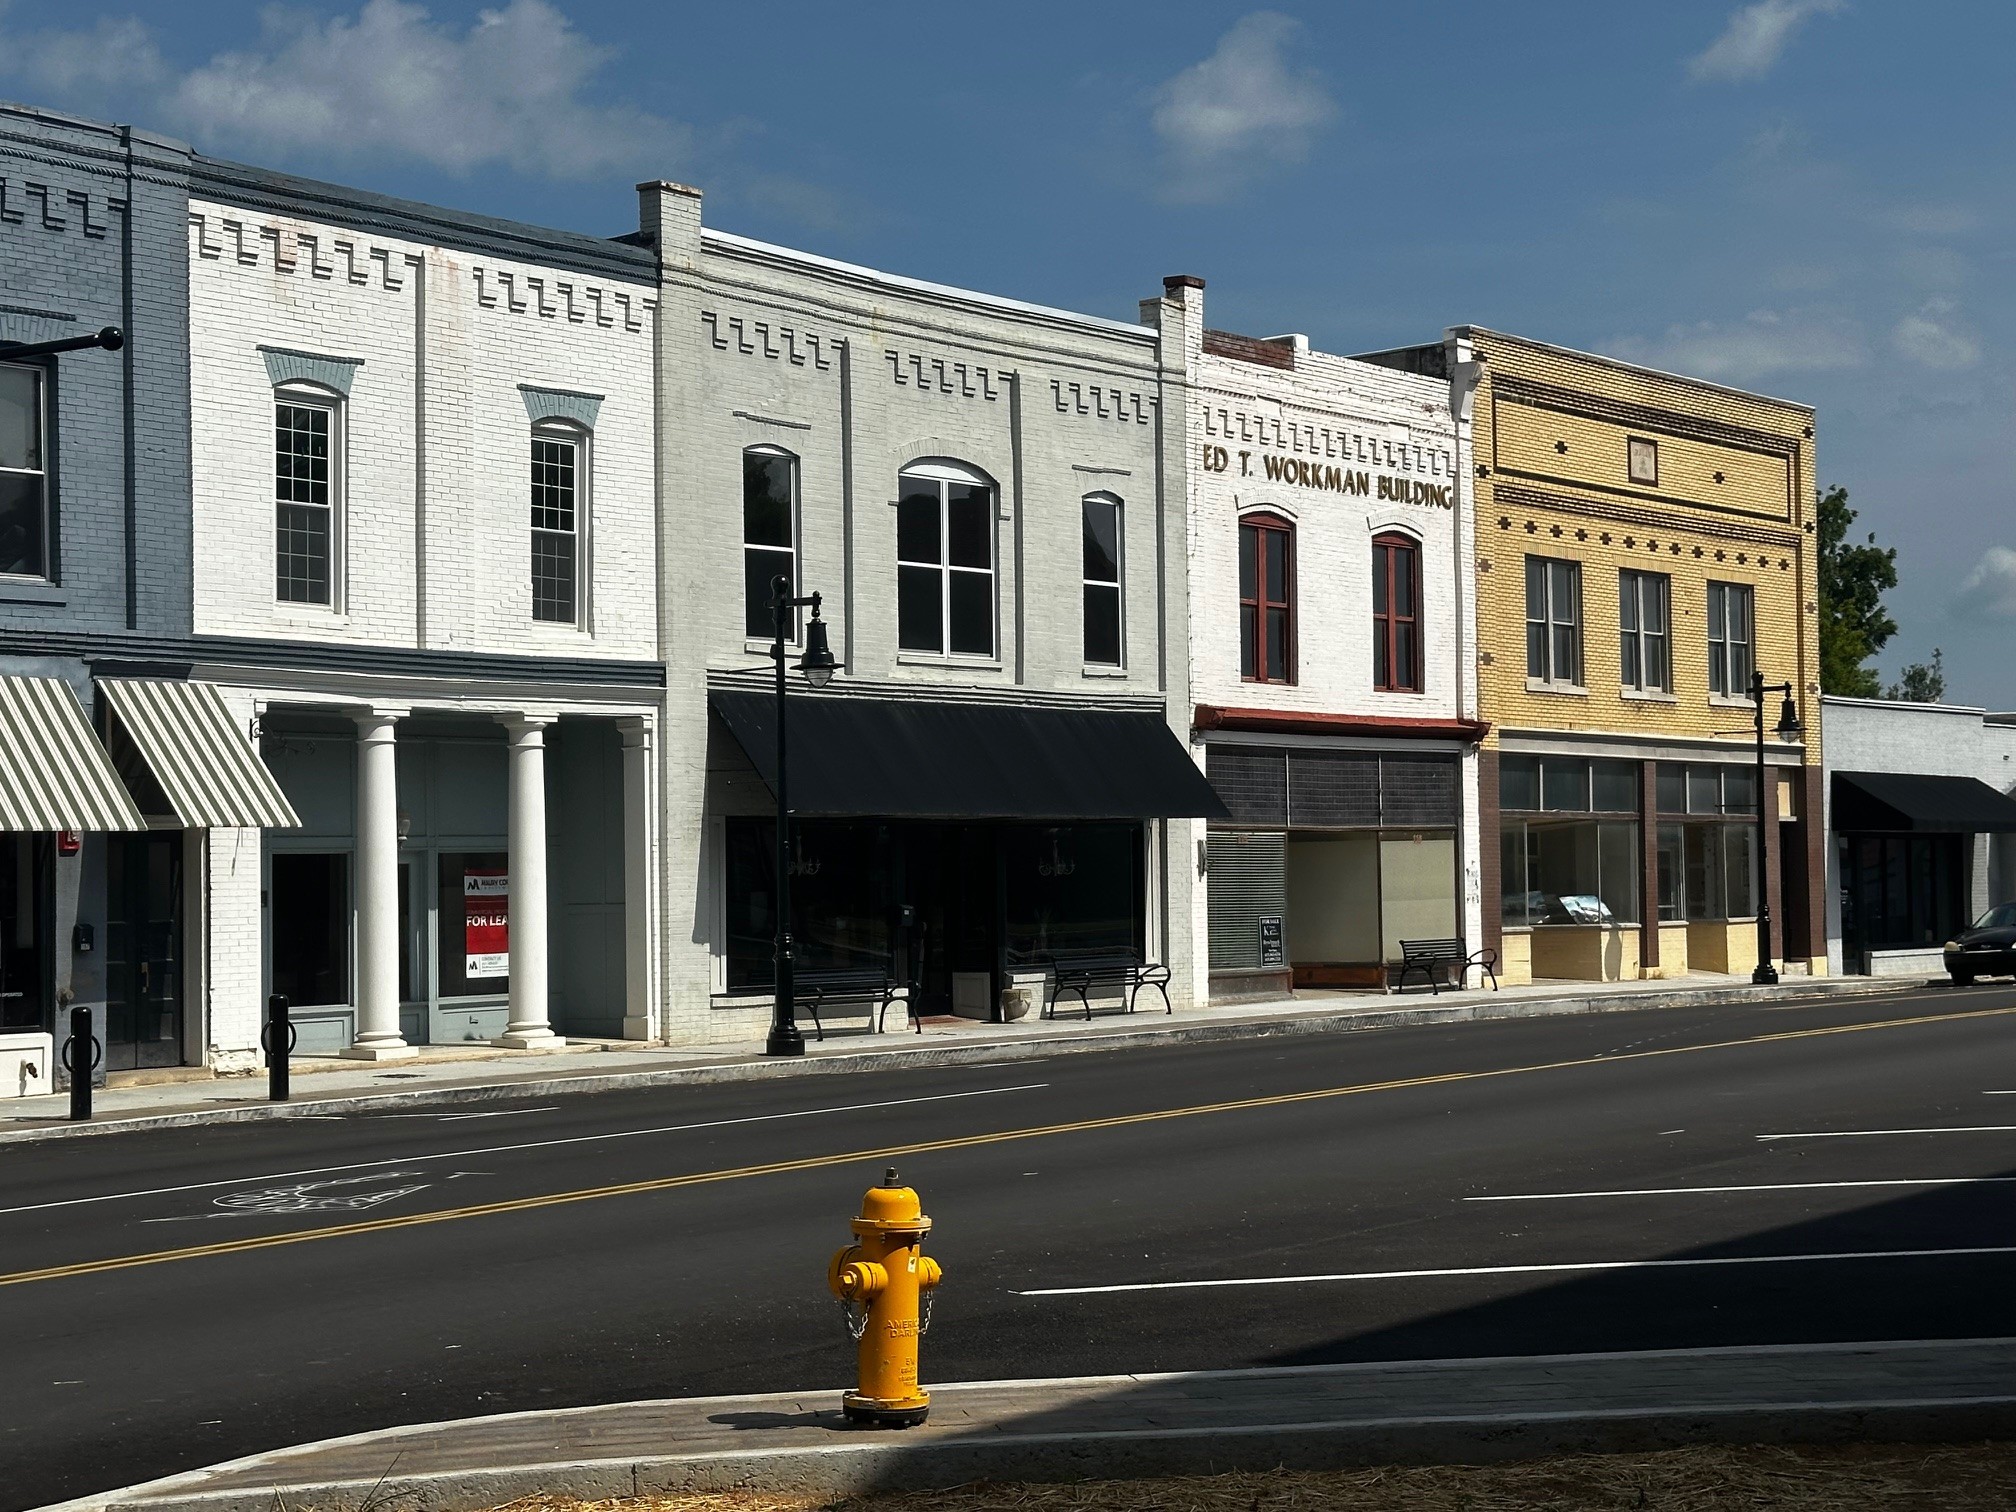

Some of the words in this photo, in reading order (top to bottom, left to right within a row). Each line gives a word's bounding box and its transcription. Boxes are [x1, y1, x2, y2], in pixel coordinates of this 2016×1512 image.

[1203, 444, 1229, 472] ED
[1238, 451, 1253, 477] T.
[1263, 454, 1370, 497] WORKMAN
[1377, 475, 1453, 510] BUILDING
[466, 915, 488, 927] FOR
